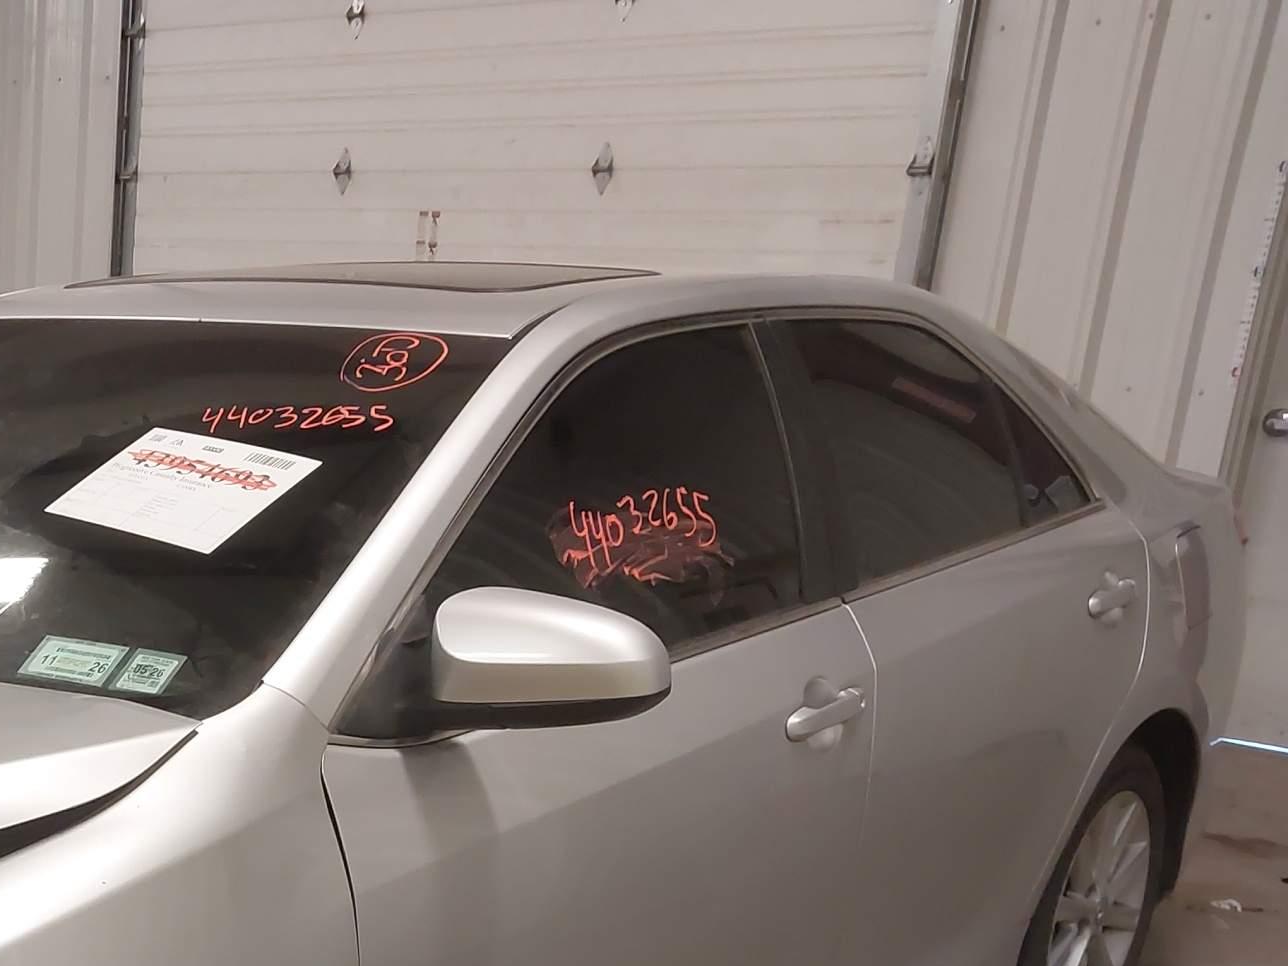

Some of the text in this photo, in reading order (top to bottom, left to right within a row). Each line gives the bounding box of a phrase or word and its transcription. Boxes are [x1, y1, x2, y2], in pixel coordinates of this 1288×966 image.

[201, 404, 394, 434] 44032655
[569, 486, 717, 570] 44032655
[41, 655, 59, 666] 11
[88, 661, 110, 675] 26
